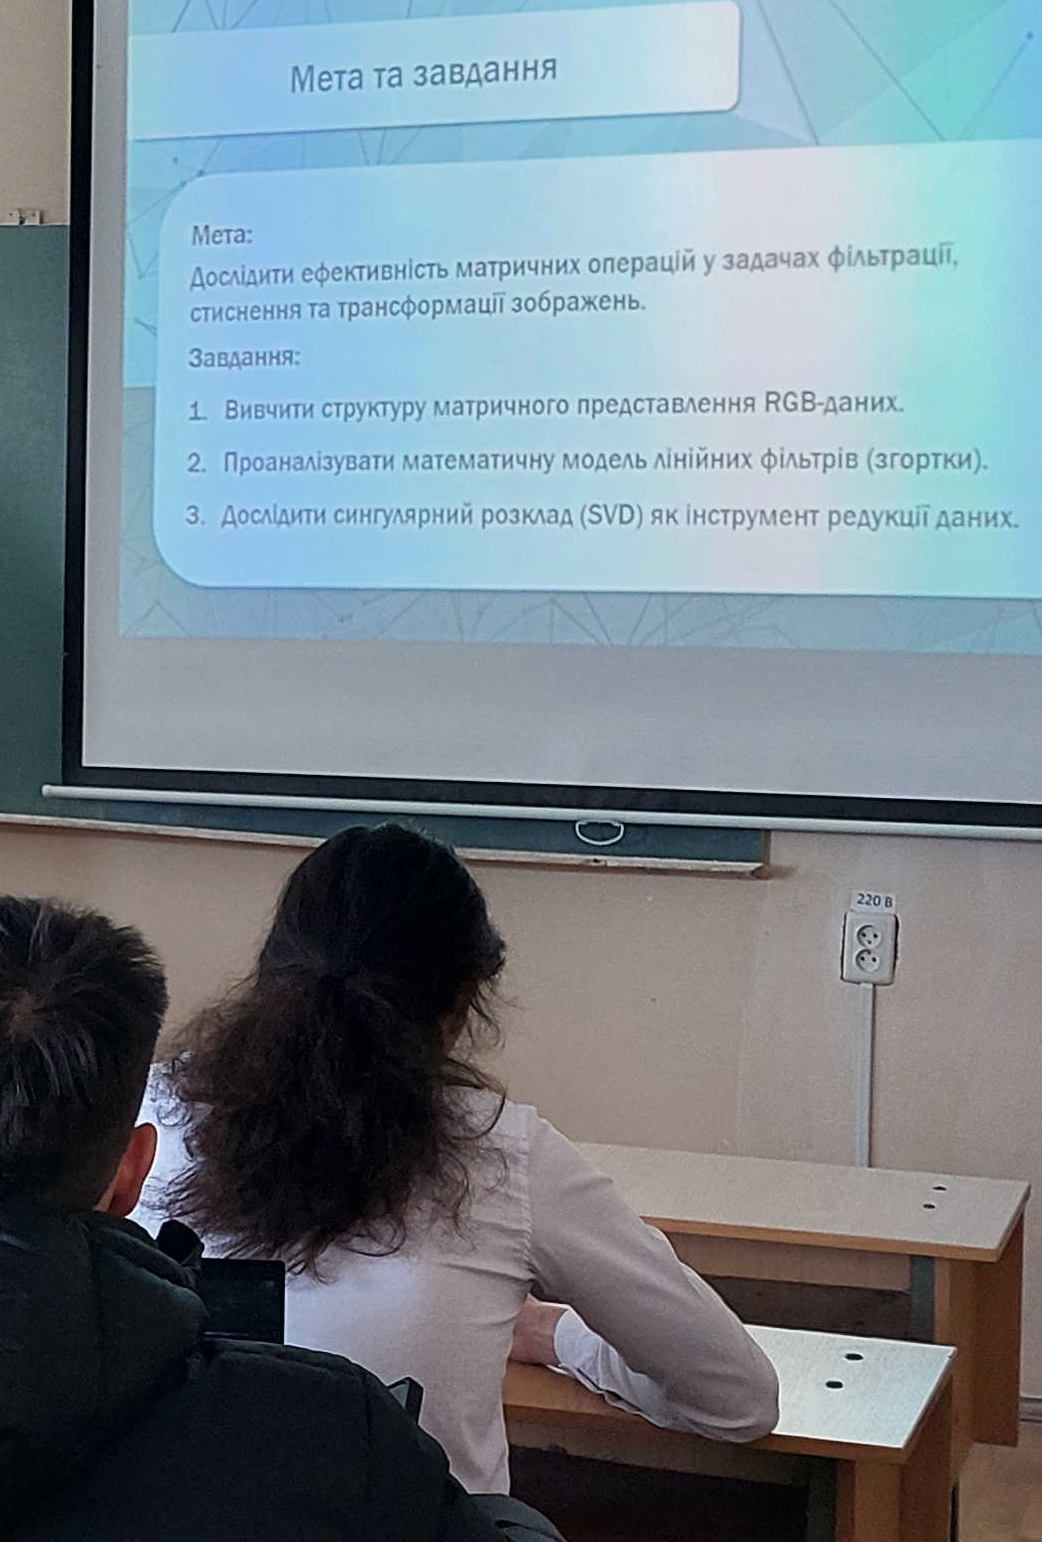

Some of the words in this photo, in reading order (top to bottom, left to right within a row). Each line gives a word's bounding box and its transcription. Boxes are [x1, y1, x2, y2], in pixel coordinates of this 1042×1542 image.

[290, 65, 364, 93] Мета
[373, 63, 403, 89] та
[413, 57, 558, 89] завдання
[191, 225, 253, 246] Мета:
[189, 265, 294, 291] Дослідити
[301, 259, 448, 286] ефективність
[455, 257, 581, 282] матричних
[588, 247, 696, 278] операцій
[703, 254, 716, 277] у
[722, 251, 820, 272] задачах
[827, 241, 958, 273] фільтрації,
[189, 301, 301, 324] стиснення
[309, 300, 331, 320] та
[338, 292, 505, 321] трансформації
[511, 290, 646, 319] зображень.
[188, 348, 301, 370] Завдання:
[224, 399, 315, 420] Вивчити
[321, 400, 426, 422] структуру
[433, 397, 570, 421] матричного
[577, 395, 757, 419] представлення
[764, 390, 905, 416] RGB-даних.
[186, 451, 206, 473] 2.
[223, 450, 395, 476] Проаналізувати
[402, 452, 556, 475] математичну
[562, 450, 647, 473] модель
[652, 447, 753, 470] лінійних
[760, 447, 859, 475] фільтрів
[866, 446, 989, 474] (згортки).
[186, 504, 206, 526] 3.
[221, 503, 326, 529] Дослідити
[333, 501, 474, 529] сингулярний
[481, 504, 574, 529] розклад
[580, 502, 643, 529] (SVD)
[651, 506, 679, 527] як
[685, 503, 820, 531] інструмент
[827, 504, 930, 534] редукції
[935, 506, 1019, 531] даних.
[857, 892, 881, 907] 220
